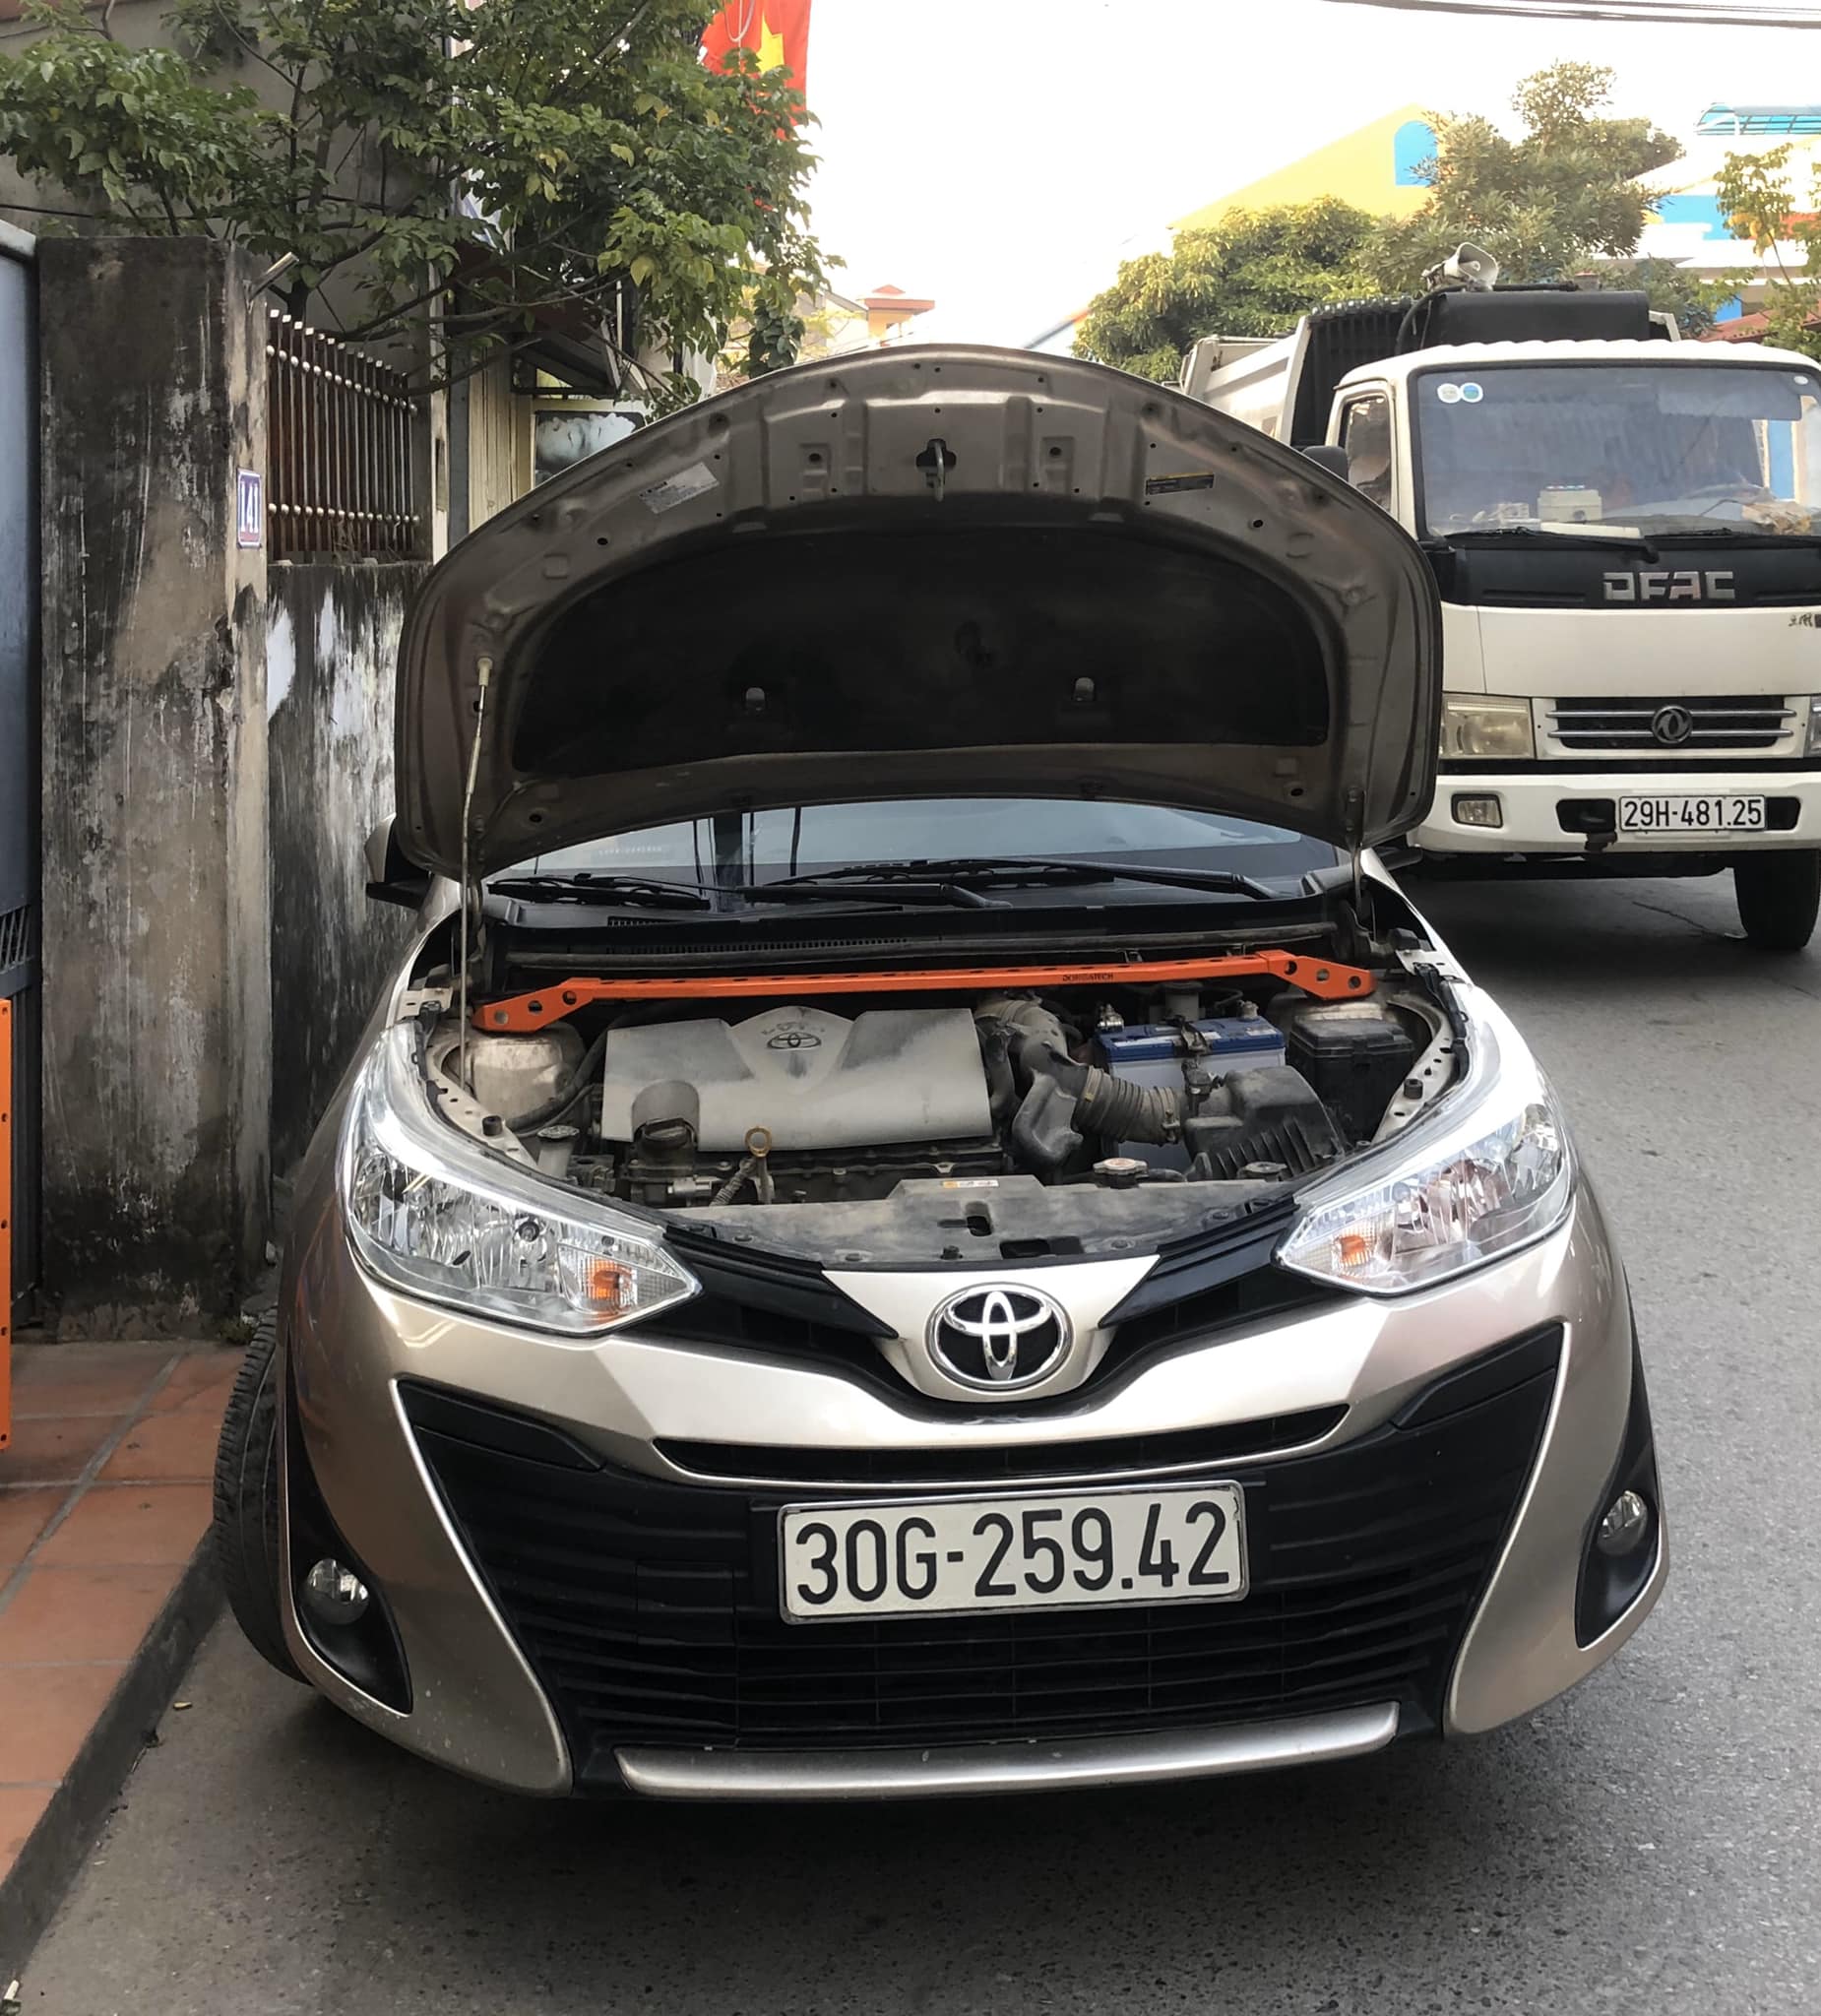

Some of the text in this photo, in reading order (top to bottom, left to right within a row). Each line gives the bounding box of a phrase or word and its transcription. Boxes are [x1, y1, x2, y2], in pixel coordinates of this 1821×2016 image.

[240, 479, 259, 534] 141
[1602, 570, 1736, 600] DFAC
[1623, 798, 1763, 827] 29H-481.25
[795, 1500, 1229, 1605] 30G-259.42
